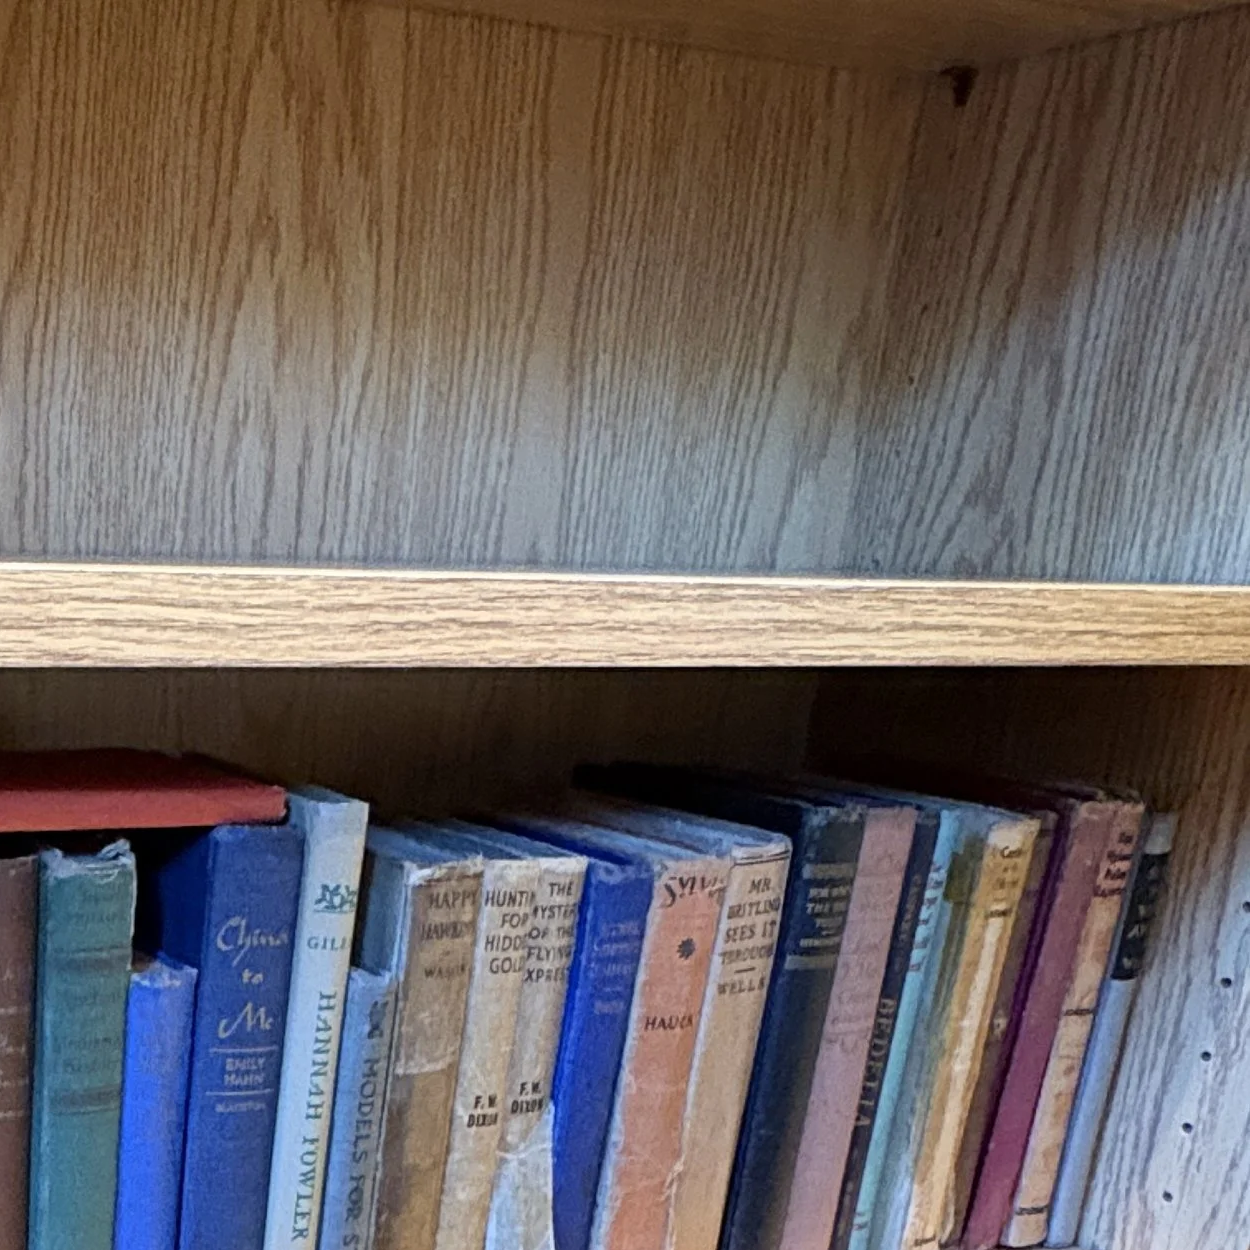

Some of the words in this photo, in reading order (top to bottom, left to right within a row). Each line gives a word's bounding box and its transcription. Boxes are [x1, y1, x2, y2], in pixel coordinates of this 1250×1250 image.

[548, 881, 574, 898] THE
[216, 915, 290, 967] China
[725, 924, 756, 944] SEES
[761, 919, 777, 938] IT
[241, 968, 264, 985] to
[217, 1002, 274, 1040] Me
[225, 1057, 266, 1072] EMILY
[305, 989, 337, 1120] HANNAH
[352, 1056, 380, 1163] MODELS
[510, 1098, 545, 1114] DIXON
[345, 1175, 366, 1222] FOR
